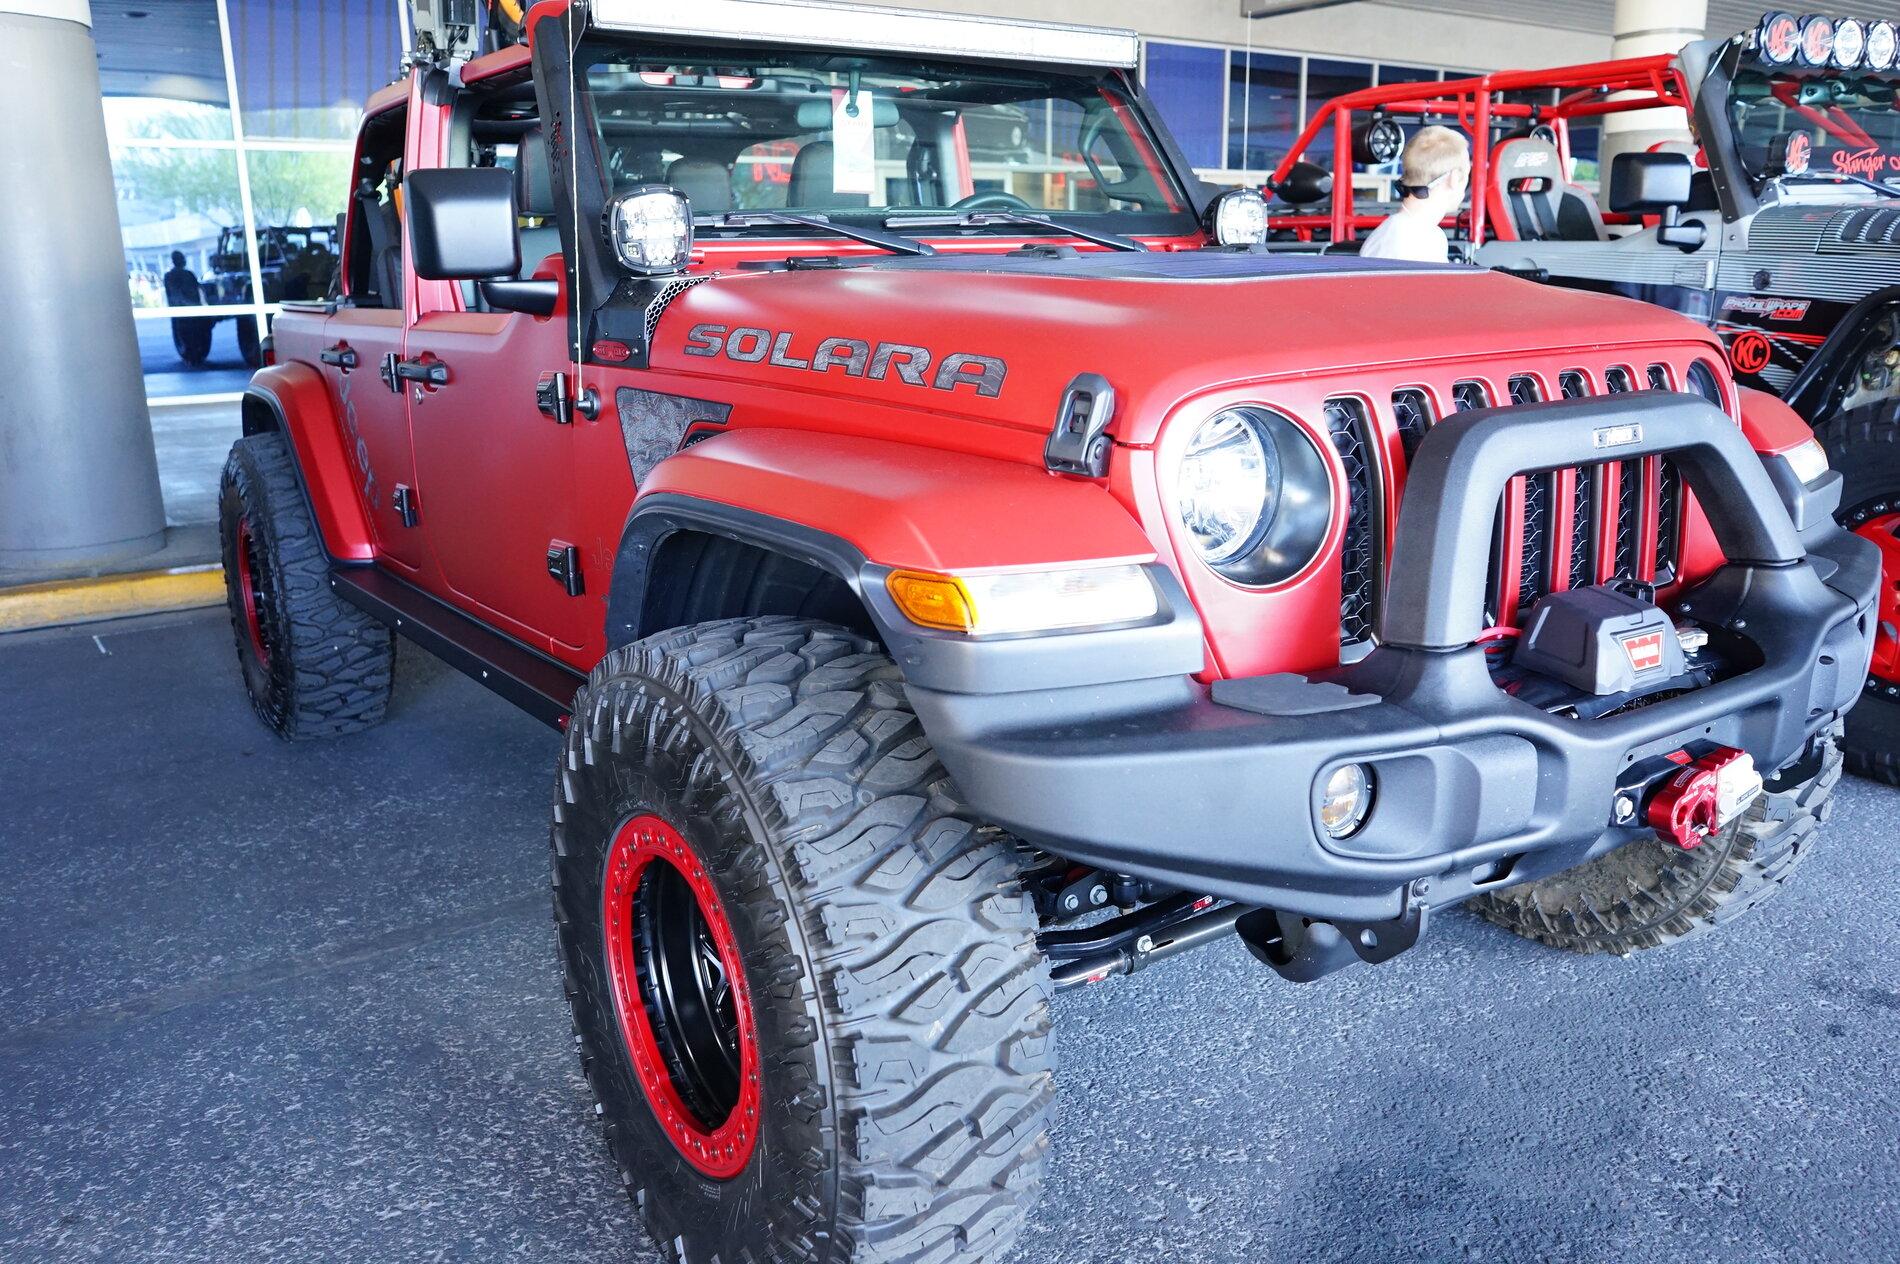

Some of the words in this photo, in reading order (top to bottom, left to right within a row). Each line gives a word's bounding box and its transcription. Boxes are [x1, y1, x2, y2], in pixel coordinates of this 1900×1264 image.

[1832, 147, 1886, 183] Stinger
[684, 323, 1008, 400] SOLARA
[1737, 336, 1764, 369] KC
